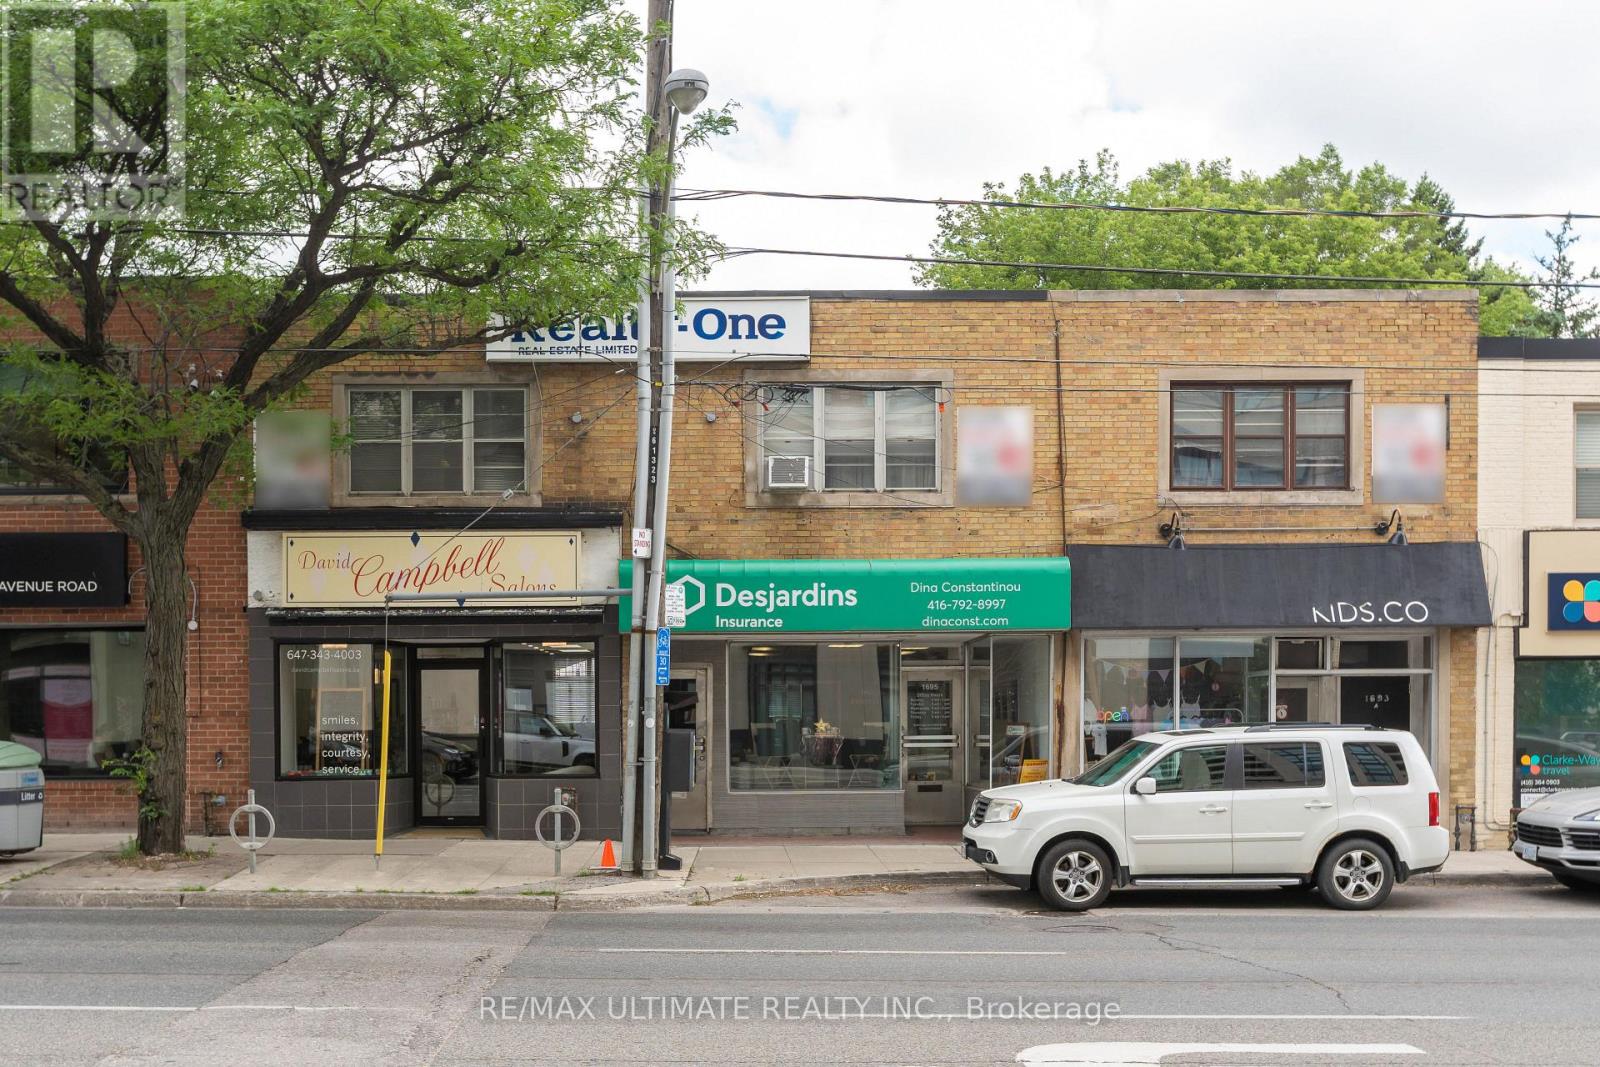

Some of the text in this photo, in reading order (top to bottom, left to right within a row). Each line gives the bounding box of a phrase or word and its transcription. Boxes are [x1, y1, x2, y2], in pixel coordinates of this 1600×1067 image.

[518, 345, 638, 356] REAL ESTATE LIMITED
[298, 550, 351, 569] David
[351, 536, 505, 598] Campbell
[0, 581, 98, 592] AVENUE ROAD
[910, 581, 1021, 593] Dina Constantinou
[716, 583, 858, 613] Desjardins
[927, 599, 1006, 610] 416-792-8997
[715, 615, 783, 628] Insurance
[921, 616, 1009, 627] dinaconst.com
[287, 649, 362, 660] 647-343-4003
[1543, 767, 1569, 775] travel
